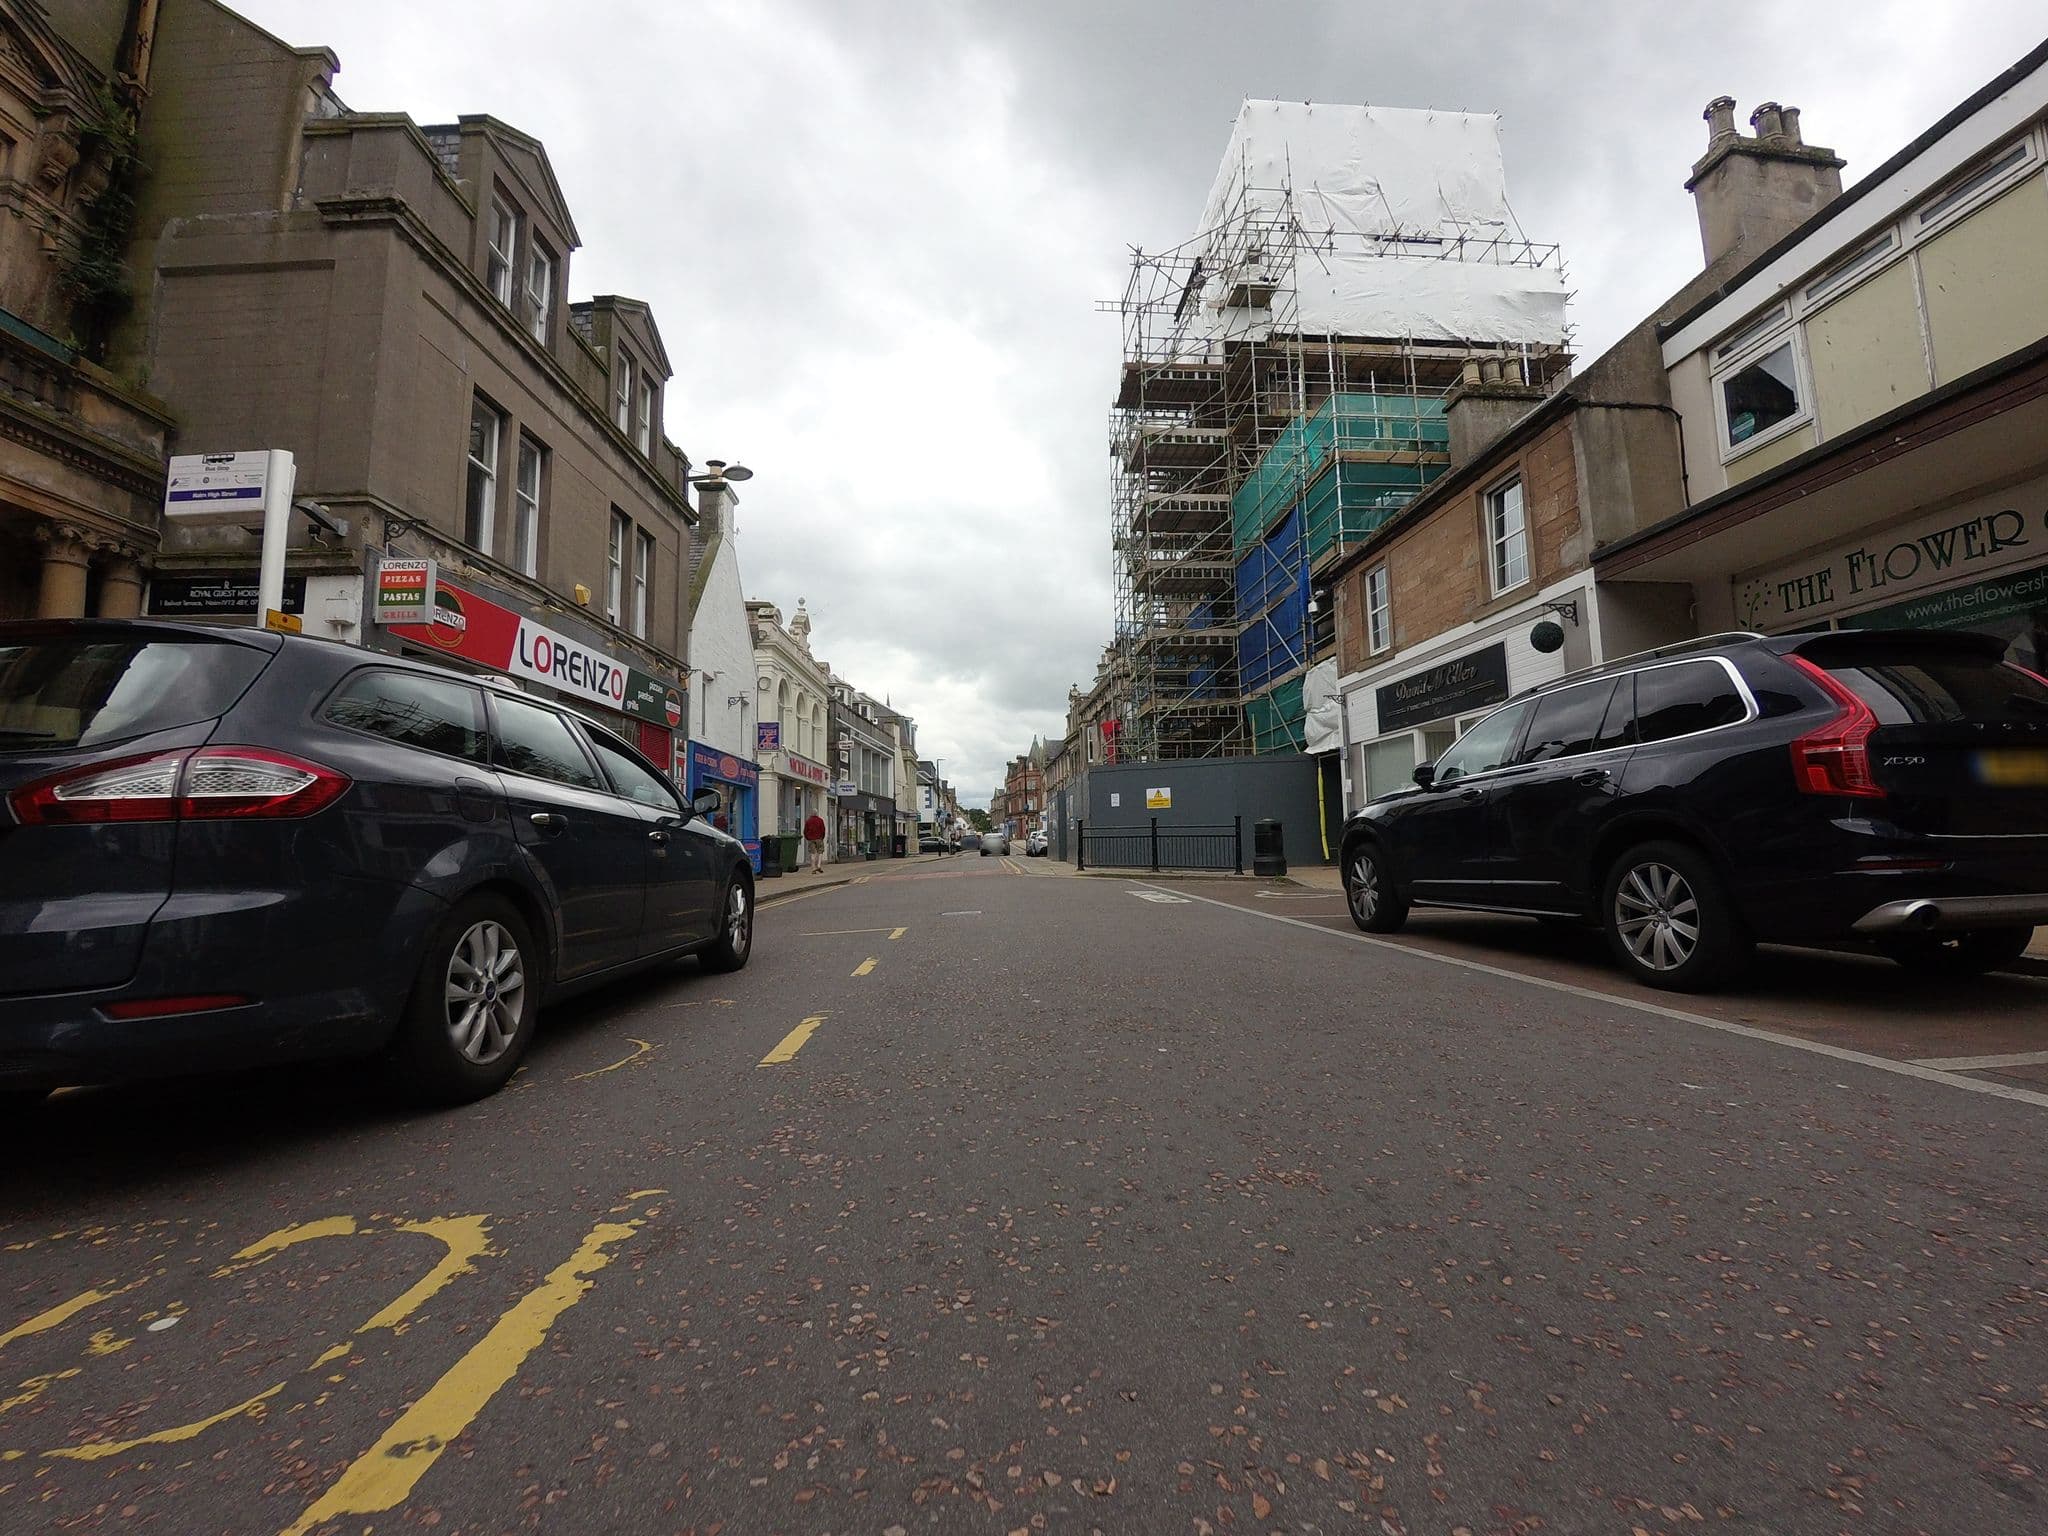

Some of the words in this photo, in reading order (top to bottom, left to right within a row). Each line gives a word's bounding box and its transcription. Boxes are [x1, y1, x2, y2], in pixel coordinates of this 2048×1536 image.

[383, 561, 428, 570] LORENZO
[1778, 567, 1834, 613] THE
[1845, 509, 2029, 595] FLOWER
[384, 575, 422, 583] PIZZAS
[190, 590, 212, 598] ROYAL
[212, 589, 236, 598] GUEST
[383, 592, 421, 601] PASTAS
[383, 610, 417, 619] GRILLS
[519, 627, 623, 701] LORENZO
[1395, 674, 1430, 701] David
[1883, 756, 1925, 766] XC90
